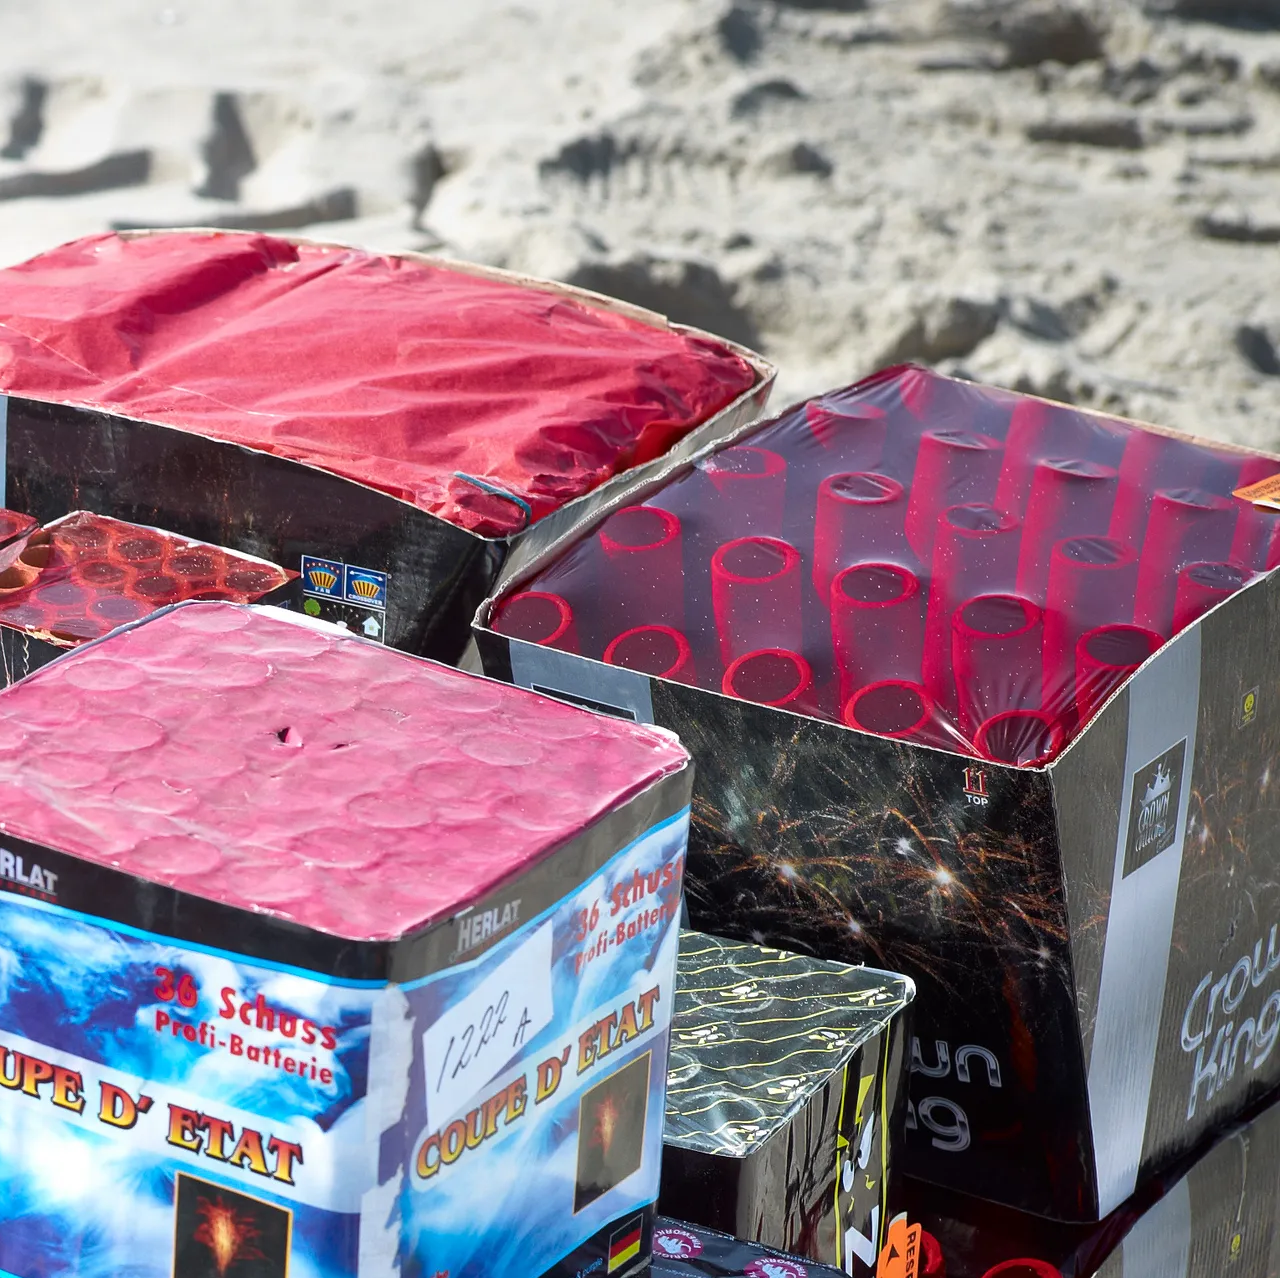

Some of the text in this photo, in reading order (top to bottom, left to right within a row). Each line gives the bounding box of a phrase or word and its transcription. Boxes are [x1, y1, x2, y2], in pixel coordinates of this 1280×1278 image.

[965, 794, 989, 806] TOP
[1137, 791, 1171, 834] CROWN
[457, 899, 522, 952] HERLAT
[154, 966, 337, 1051] 36 Schuss
[155, 1010, 334, 1086] Profi-Batterie
[416, 1072, 528, 1181] COUPE
[577, 984, 661, 1078] ETAT
[1186, 988, 1280, 1122] King
[166, 1103, 304, 1186] ETAT
